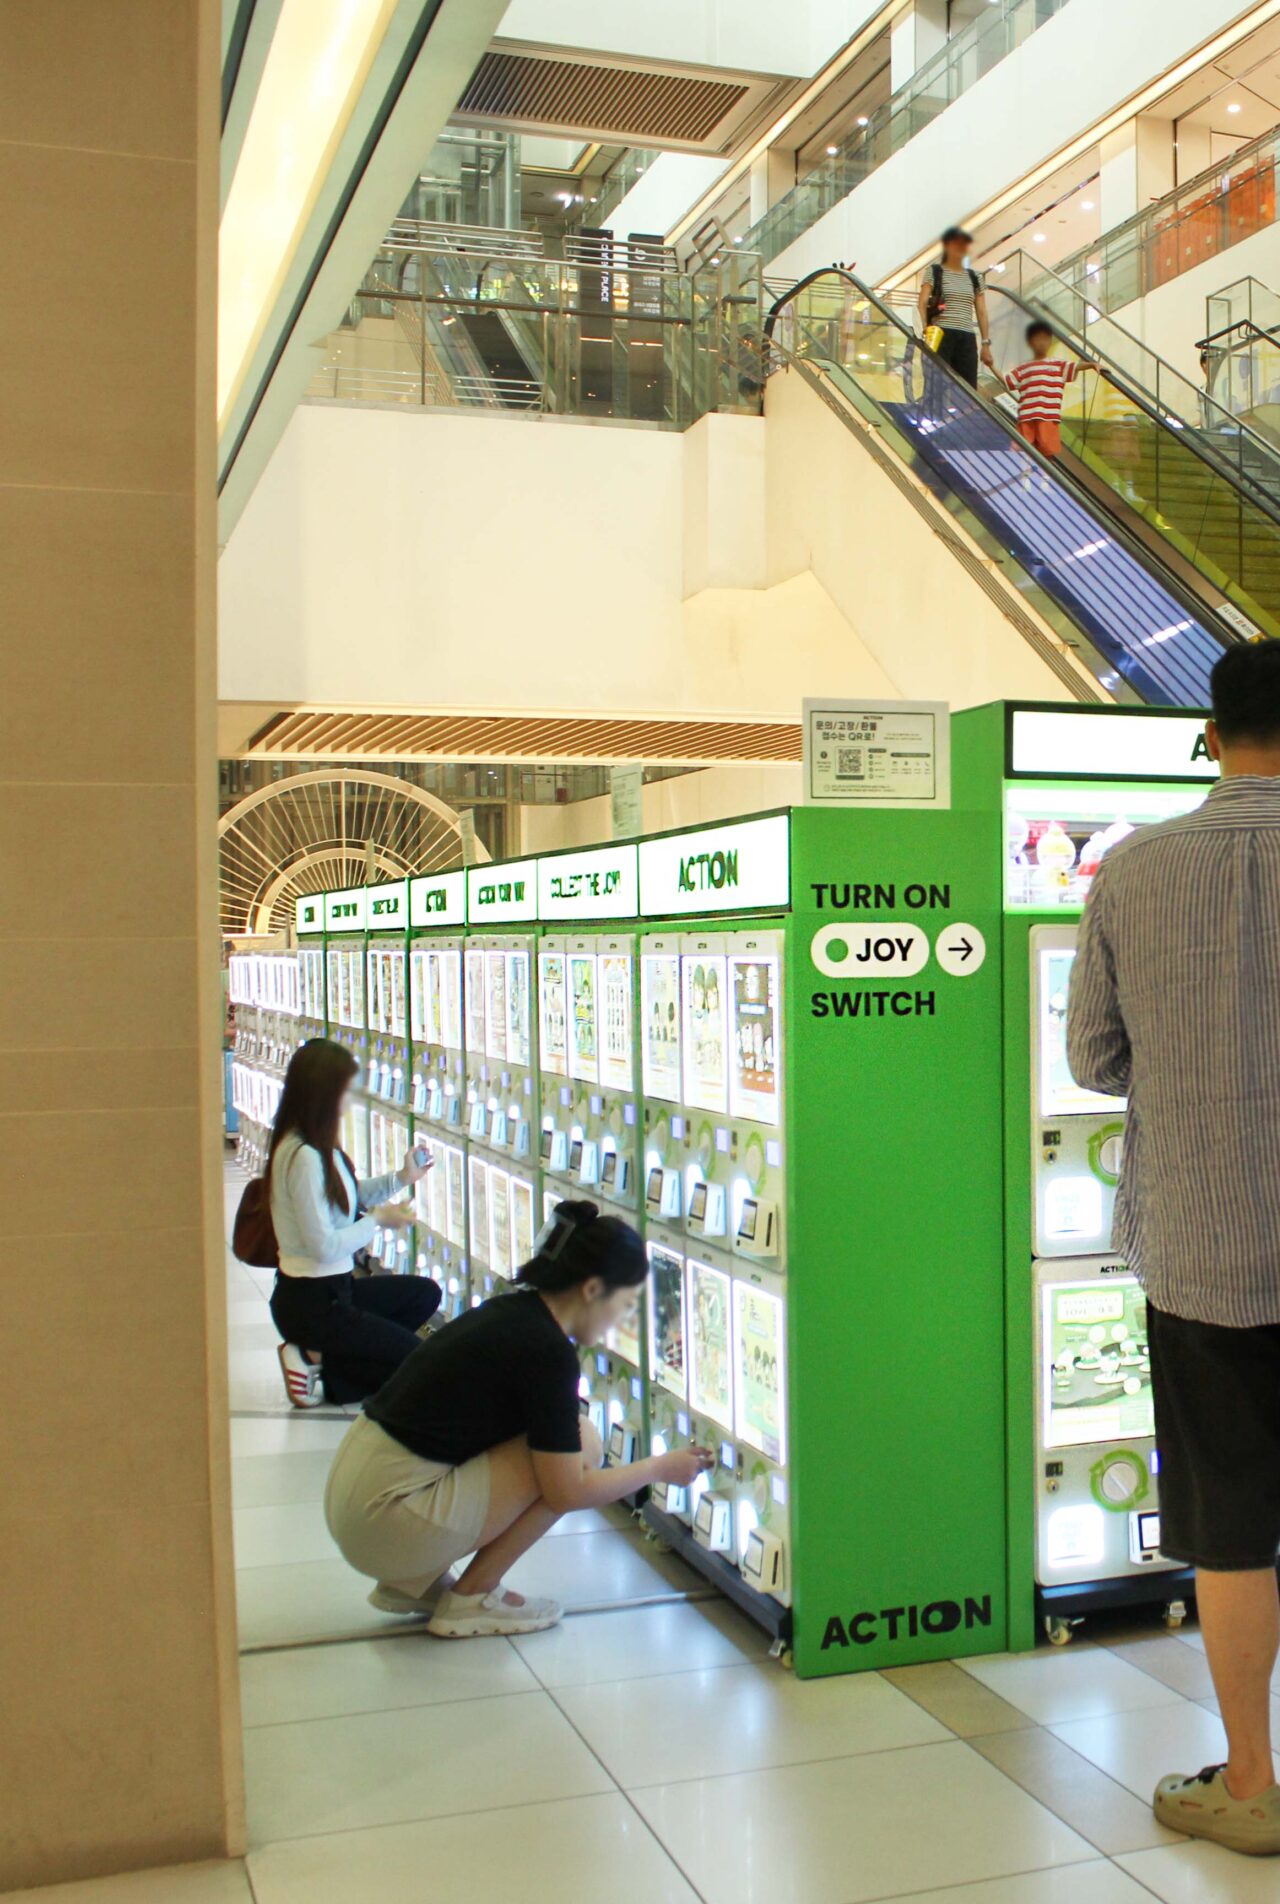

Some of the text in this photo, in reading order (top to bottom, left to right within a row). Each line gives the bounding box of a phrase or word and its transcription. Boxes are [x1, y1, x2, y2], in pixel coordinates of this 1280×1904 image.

[678, 849, 738, 892] ACTION
[811, 883, 950, 909] TURN ON
[855, 937, 914, 962] JOY
[811, 990, 936, 1018] SWITCH
[820, 1594, 992, 1650] ACTION
